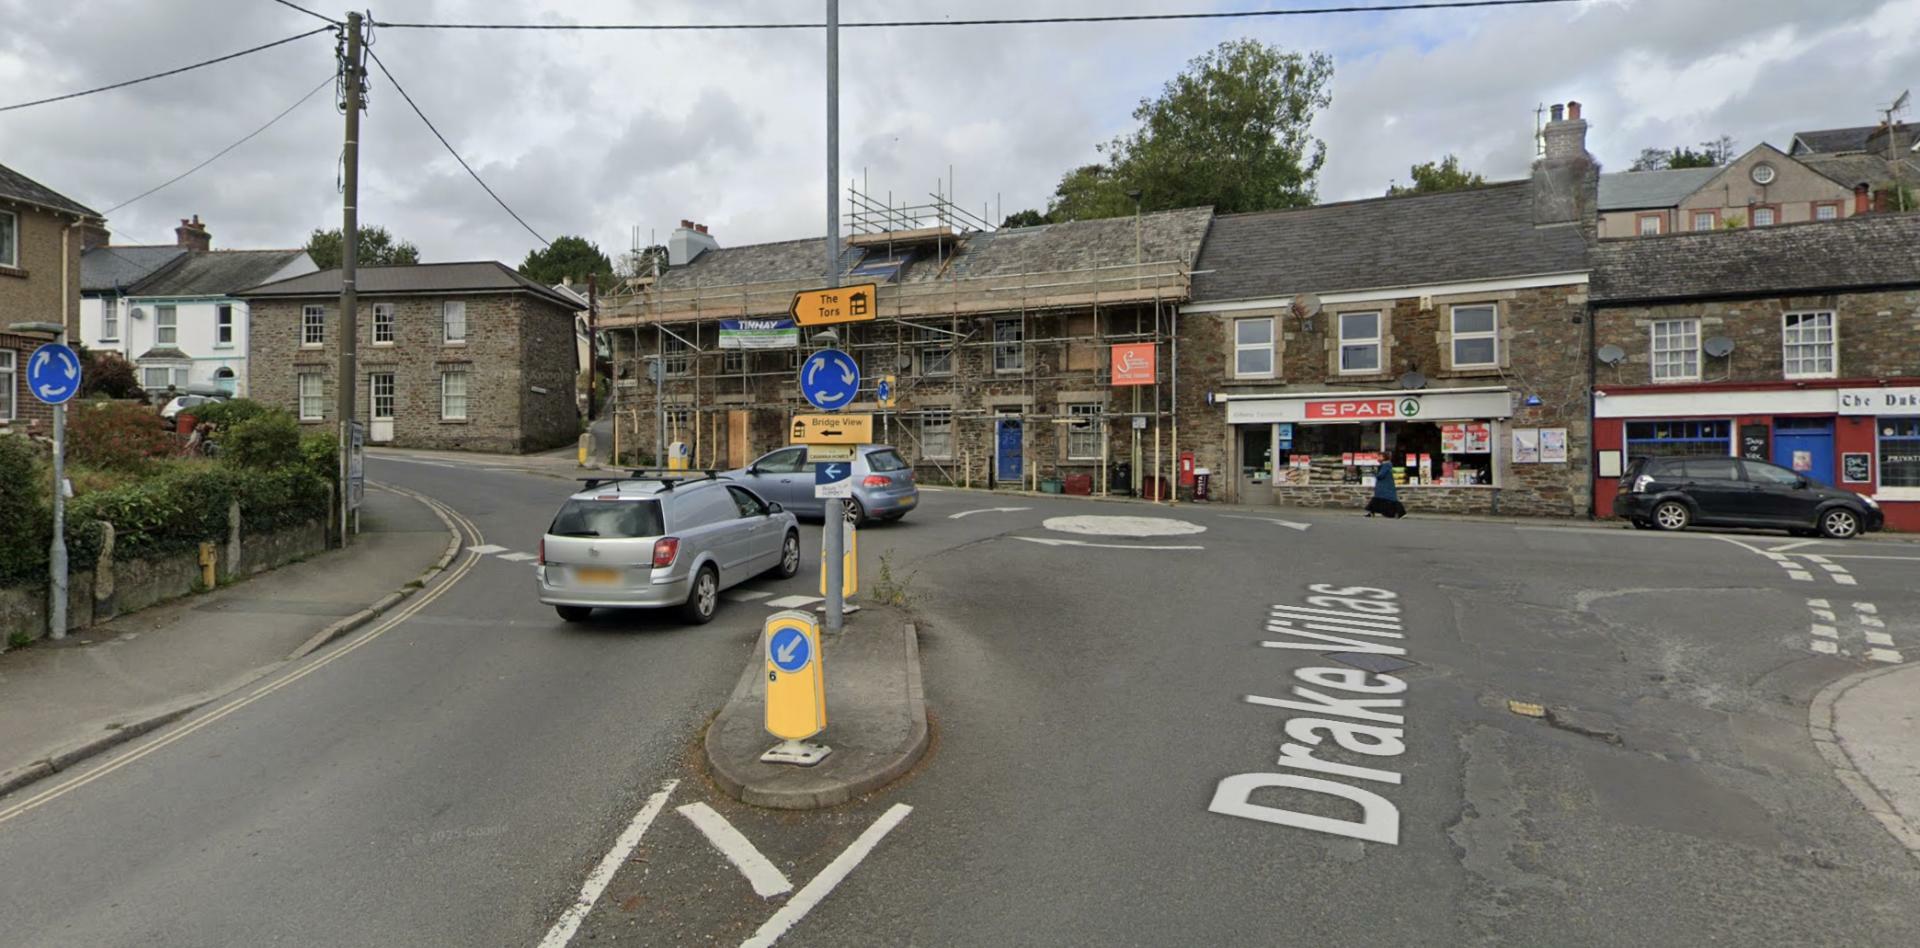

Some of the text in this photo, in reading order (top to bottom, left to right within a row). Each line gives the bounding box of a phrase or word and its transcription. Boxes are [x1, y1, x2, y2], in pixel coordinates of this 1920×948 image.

[820, 294, 838, 304] The
[819, 306, 840, 317] Tors
[1842, 393, 1920, 407] The Duk
[1321, 402, 1393, 416] SPAR
[812, 418, 863, 428] Bridge View
